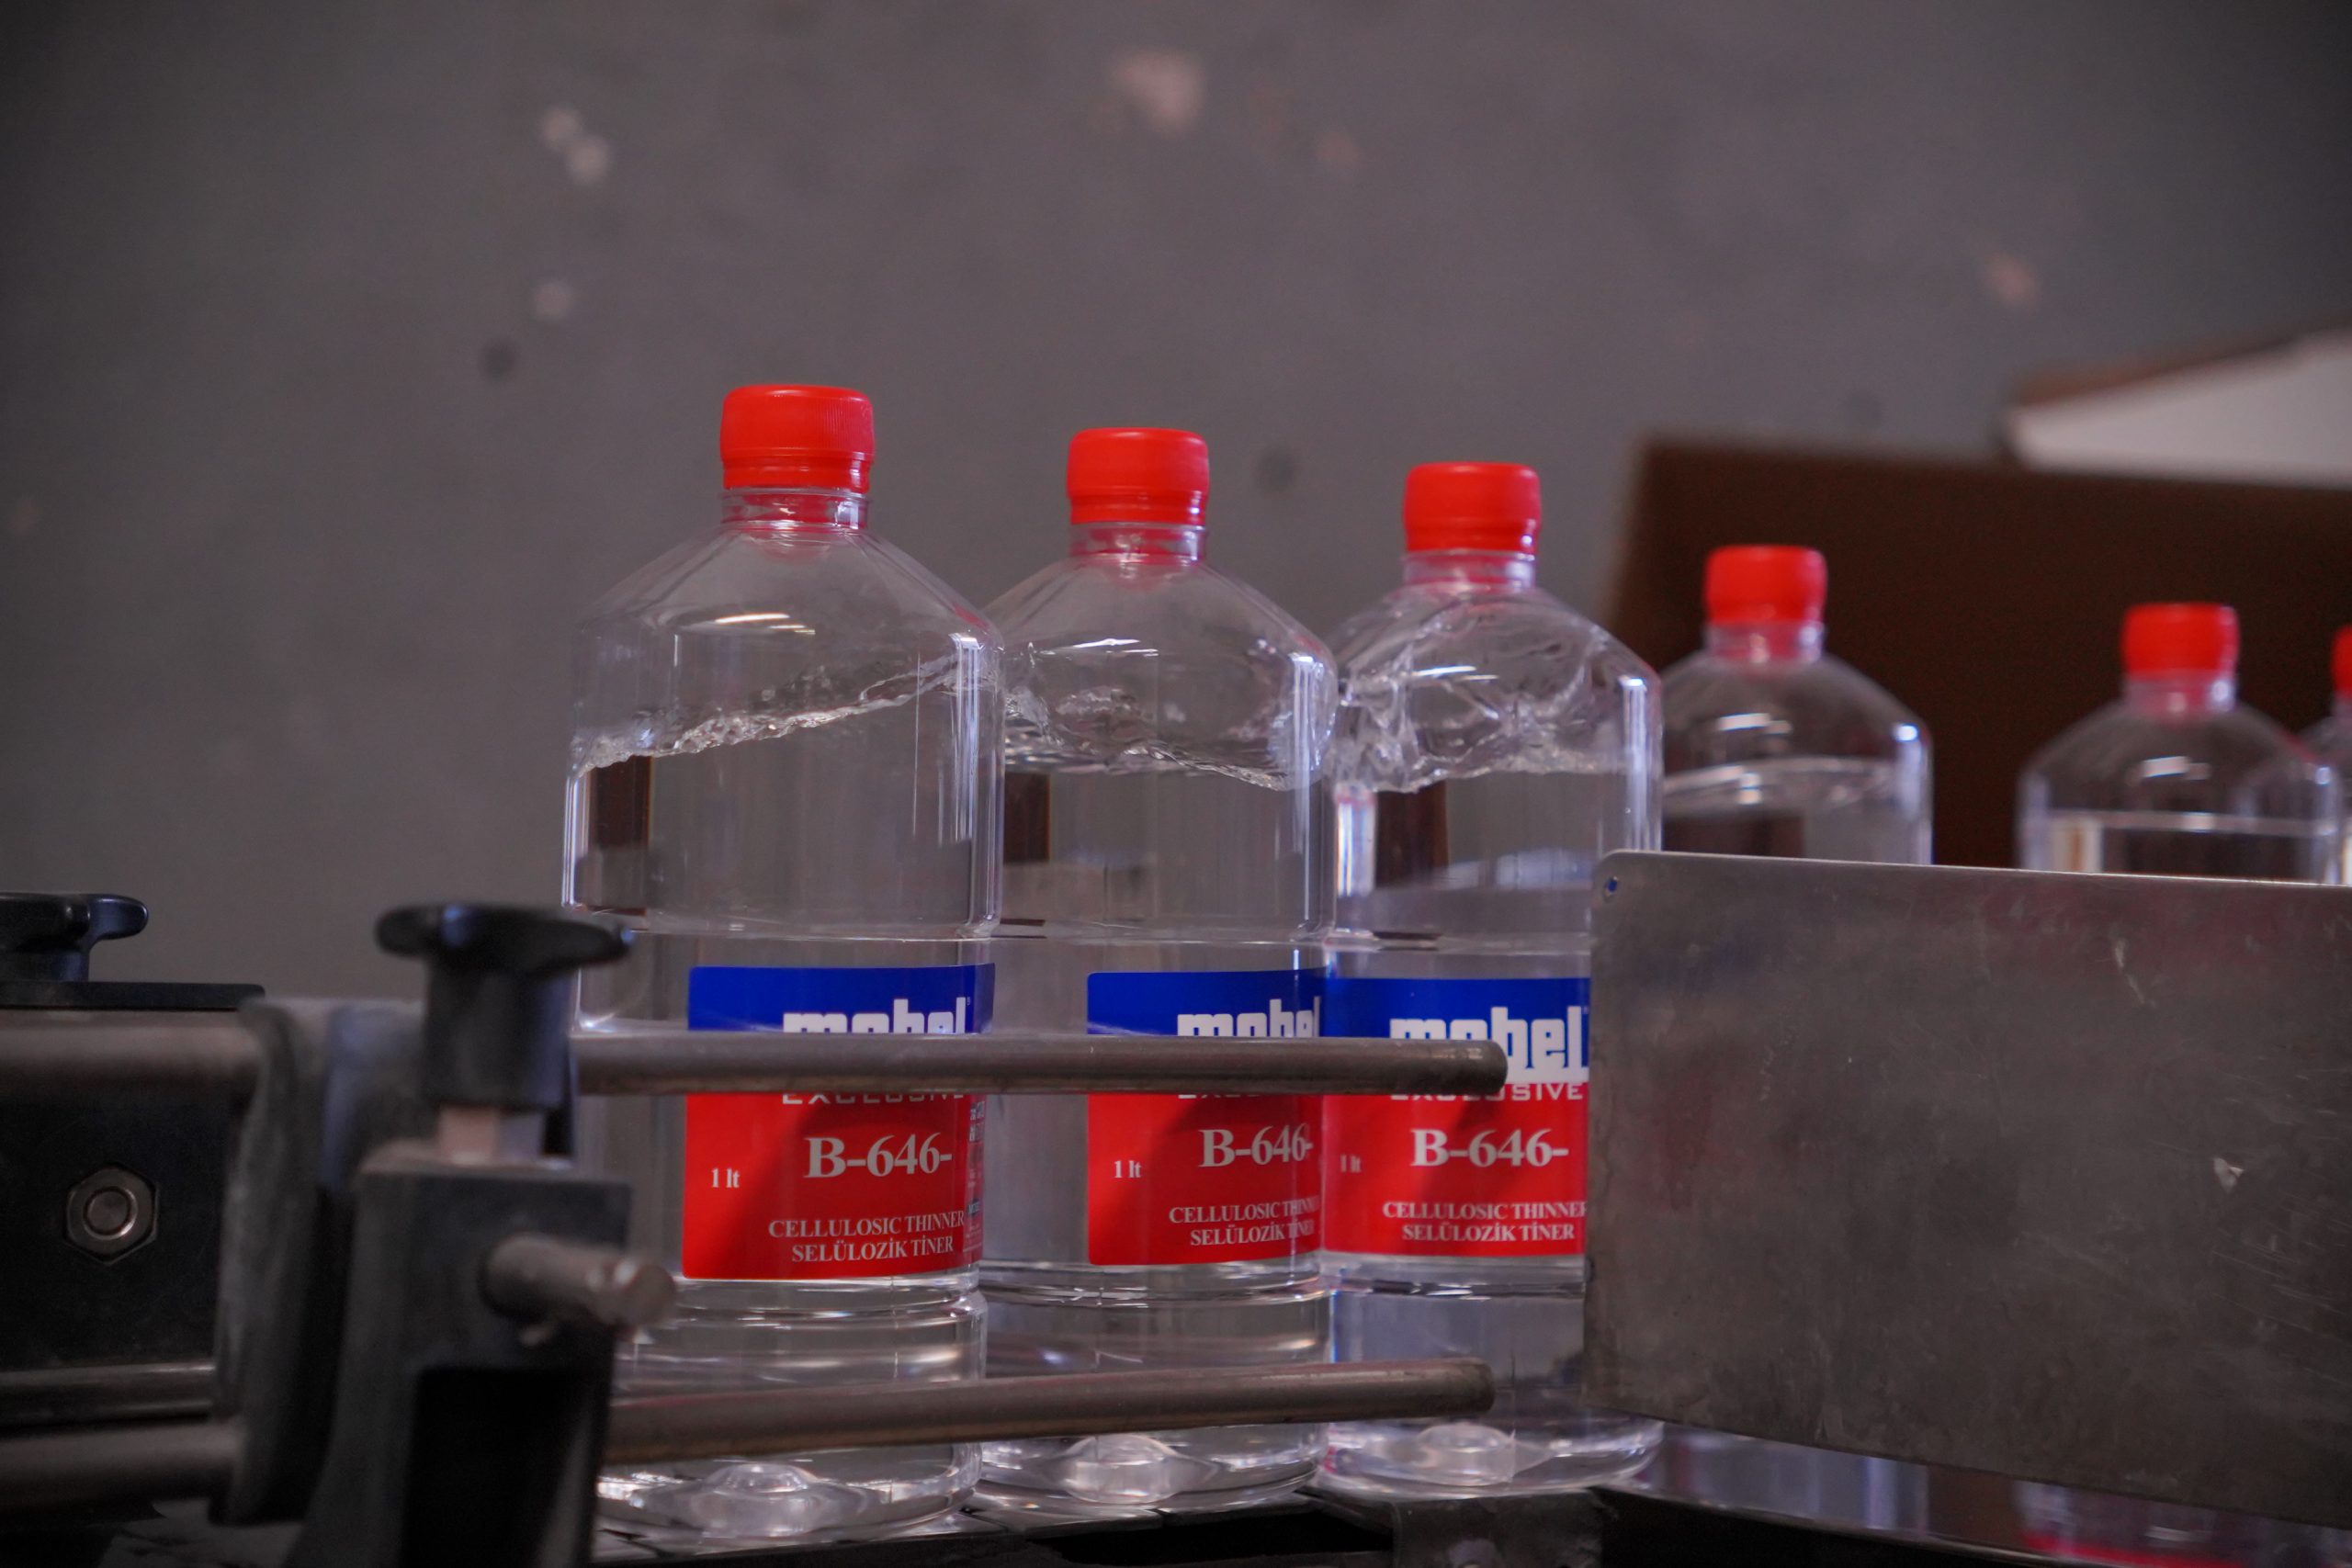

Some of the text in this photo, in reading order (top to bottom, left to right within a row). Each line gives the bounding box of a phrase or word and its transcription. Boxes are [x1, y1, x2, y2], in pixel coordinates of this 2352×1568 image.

[804, 1133, 953, 1178] B-646-
[1198, 1122, 1313, 1168] B-646-
[1410, 1129, 1568, 1167] B-646-
[711, 1168, 719, 1188] 1
[1114, 1161, 1122, 1179] 1
[1169, 1201, 1280, 1224] CELLULOSIC
[1383, 1201, 1508, 1220] CELLULOSIC
[768, 1210, 965, 1238] CELLULOSIC THINNER
[792, 1239, 908, 1262] SELÜLOZİK
